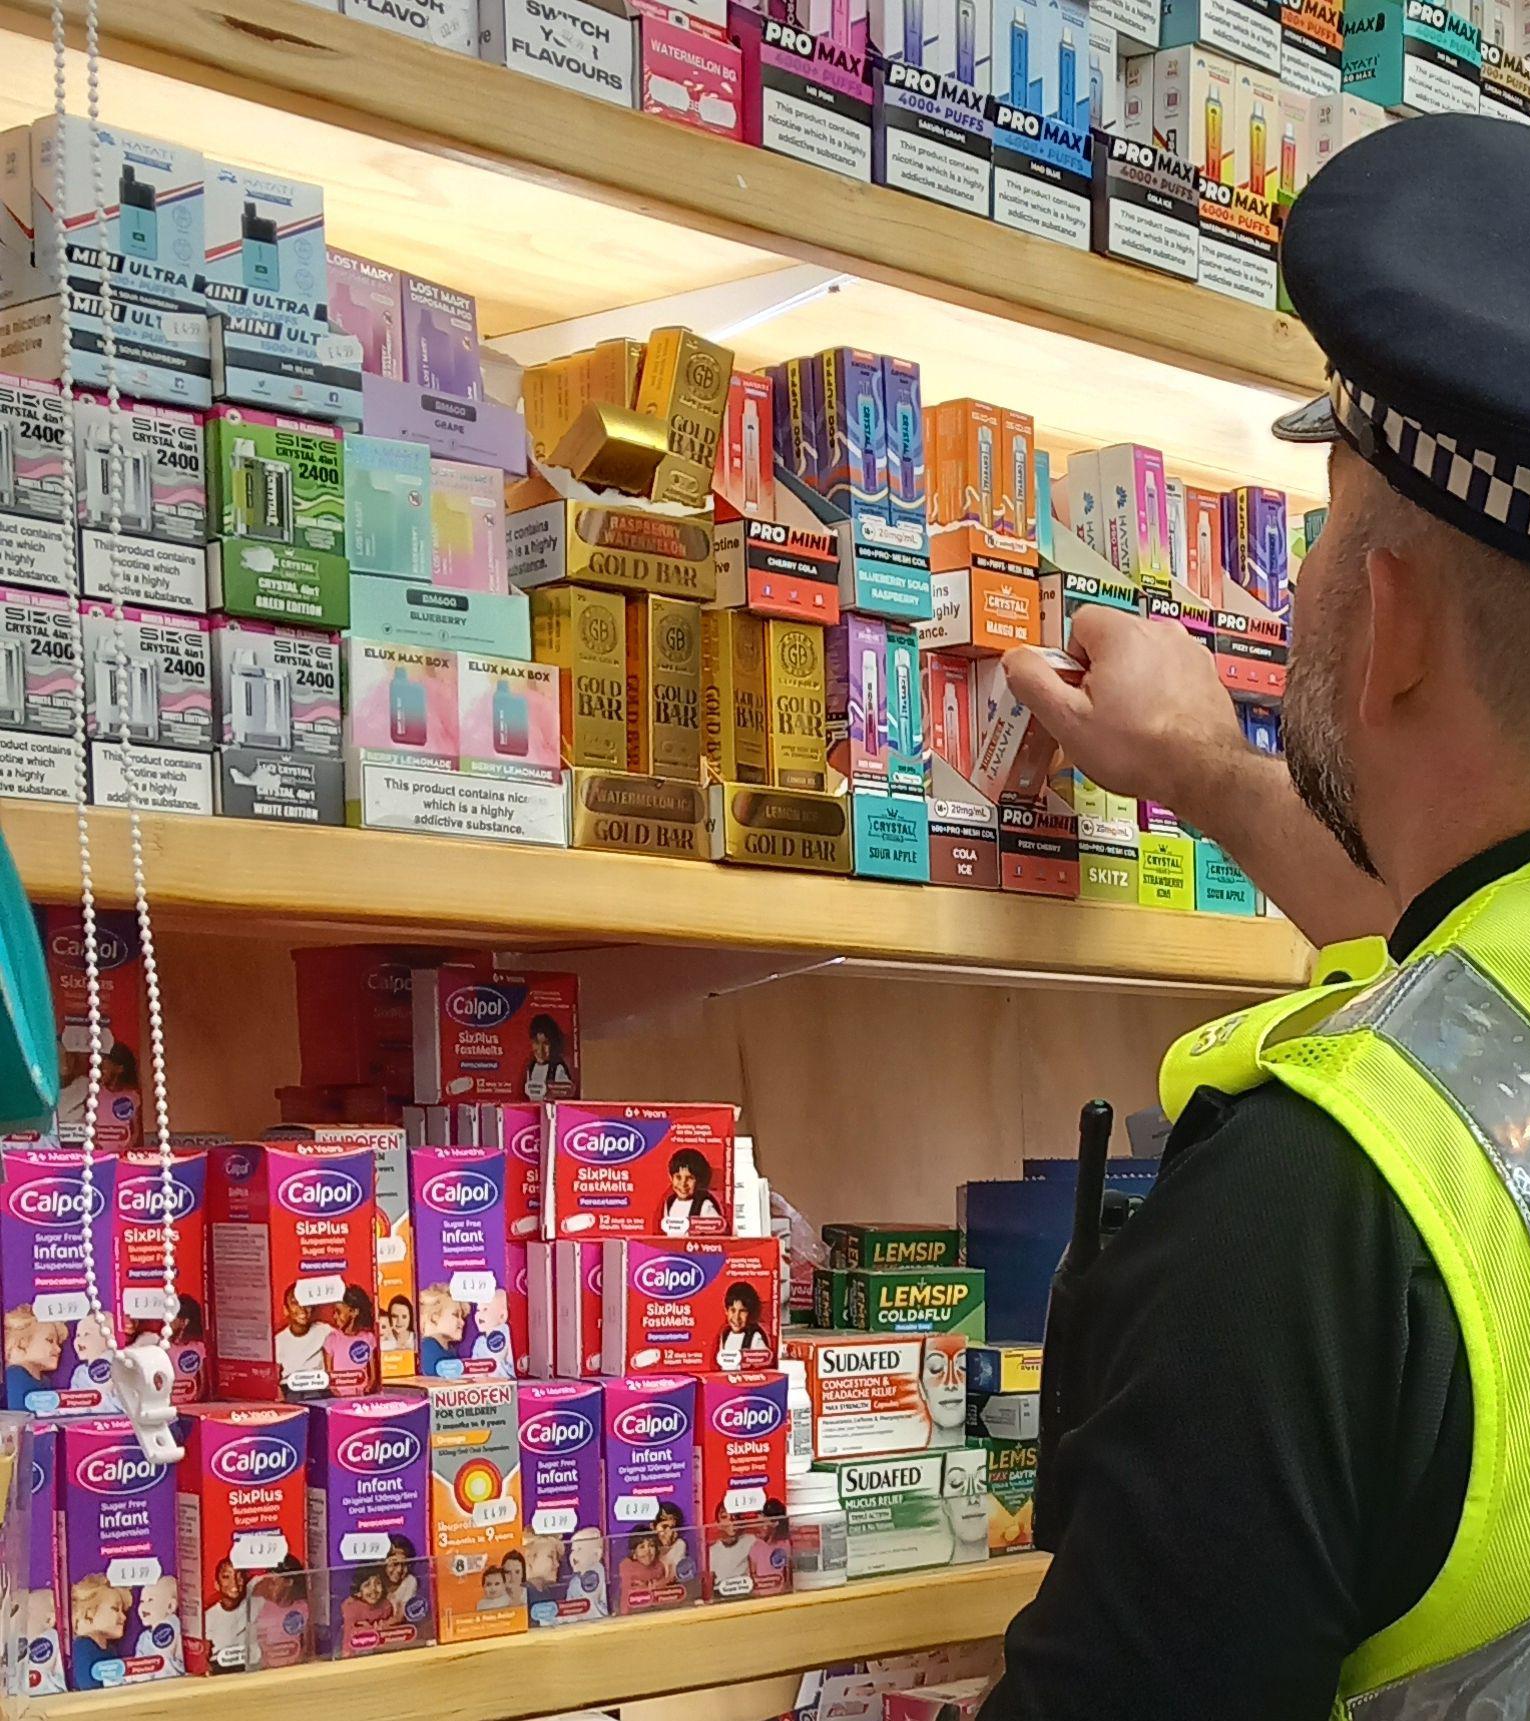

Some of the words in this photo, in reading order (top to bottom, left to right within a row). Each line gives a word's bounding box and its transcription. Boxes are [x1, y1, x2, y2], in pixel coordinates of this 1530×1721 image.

[1408, 1, 1443, 27] PRO
[1447, 16, 1478, 43] MAX
[651, 39, 721, 75] WATERMELON
[765, 20, 812, 56] PRO
[817, 41, 861, 77] MAX
[512, 38, 623, 91] FLAVOURS
[890, 65, 937, 97] PRO
[940, 83, 984, 113] MAX
[898, 91, 942, 115] 4000+
[945, 103, 985, 133] PUFFS
[997, 107, 1040, 136] PRO
[1044, 124, 1083, 153] MAX
[1113, 140, 1154, 168] PRO
[1158, 155, 1192, 183] MAX
[1199, 179, 1231, 205] PRO
[1234, 192, 1268, 218] MAX
[1238, 216, 1271, 237] PUFFS
[129, 262, 188, 289] ULTRA
[326, 252, 357, 273] LOST
[360, 261, 393, 283] MARY
[252, 292, 310, 318] ULTRA
[410, 280, 438, 299] LOST
[441, 290, 470, 309] MARY
[231, 318, 276, 340] MINI
[132, 430, 175, 447] CRYSTAL
[434, 419, 465, 435] GRAPE
[670, 413, 716, 445] GOLD
[157, 449, 199, 472] 2400
[276, 446, 317, 463] CRYSTAL
[298, 463, 339, 485] 2400
[750, 522, 785, 543] PRO
[791, 531, 827, 552] MINI
[589, 551, 650, 581] GOLD
[656, 561, 698, 589] BAR
[1066, 574, 1098, 594] PRO
[1102, 584, 1132, 603] MINI
[987, 597, 1027, 613] CRYSTAL
[1152, 599, 1180, 616] PRO
[1183, 604, 1209, 623] MINI
[410, 610, 466, 627] BLUEBERRY
[1217, 613, 1246, 631] PRO
[1250, 618, 1279, 638] MINI
[163, 657, 205, 679] 2400
[274, 654, 313, 668] CRYSTAL
[364, 647, 397, 662] ELUX
[398, 653, 425, 666] MAX
[427, 657, 450, 670] BOX
[296, 669, 335, 689] 2400
[468, 661, 498, 675] ELUX
[501, 666, 525, 679] MAX
[527, 670, 551, 684] BOX
[577, 674, 621, 697] GOLD
[654, 683, 697, 704] GOLD
[578, 693, 624, 722] BAR
[654, 701, 698, 729] BAR
[777, 695, 822, 718] GOLD
[778, 714, 824, 738] BAR
[471, 761, 499, 774] BERRY
[501, 764, 553, 781] LEMONADE
[384, 778, 409, 792] This
[412, 782, 456, 800] product
[458, 786, 506, 802] contains
[423, 797, 453, 812] which
[455, 801, 466, 813] is
[480, 803, 514, 820] highly
[1002, 808, 1032, 827] PRO
[414, 813, 463, 829] addictive
[465, 818, 525, 836] substance.
[594, 819, 649, 846] GOLD
[656, 825, 695, 851] BAR
[873, 818, 914, 834] CRYSTAL
[744, 832, 796, 857] GOLD
[801, 839, 837, 863] BAR
[953, 848, 977, 861] COLA
[957, 863, 973, 876] ICE
[1088, 866, 1129, 888] SKITZ
[453, 996, 502, 1020] Calpol
[459, 1031, 499, 1045] SixPlus
[572, 1127, 636, 1160] Calpol
[573, 1180, 634, 1193] FastMelts
[577, 1168, 630, 1182] SixPlus
[288, 1182, 352, 1208] Calpol
[432, 1181, 488, 1206] Calpol
[296, 1220, 349, 1236] SixPlus
[442, 1230, 484, 1245] Infant
[873, 1241, 947, 1264] LEMSIP
[642, 1267, 696, 1293] Calpol
[879, 1284, 969, 1309] LEMSIP
[642, 1315, 696, 1327] FastMelts
[646, 1303, 691, 1316] SixPlus
[822, 1378, 880, 1392] CONGESTION
[822, 1389, 870, 1402] HEADACHE
[435, 1388, 511, 1407] NUROFEN
[435, 1408, 454, 1419] FOR
[622, 1413, 678, 1437] Calpol
[720, 1405, 772, 1429] Calpol
[527, 1421, 584, 1446] Calpol
[222, 1447, 288, 1474] Calpol
[347, 1438, 411, 1466] Calpol
[632, 1448, 673, 1463] Infant
[727, 1442, 770, 1457] SixPlus
[357, 1476, 402, 1494] Infant
[537, 1469, 577, 1485] Infant
[229, 1489, 283, 1506] SixPlus
[100, 1510, 149, 1529] Infant
